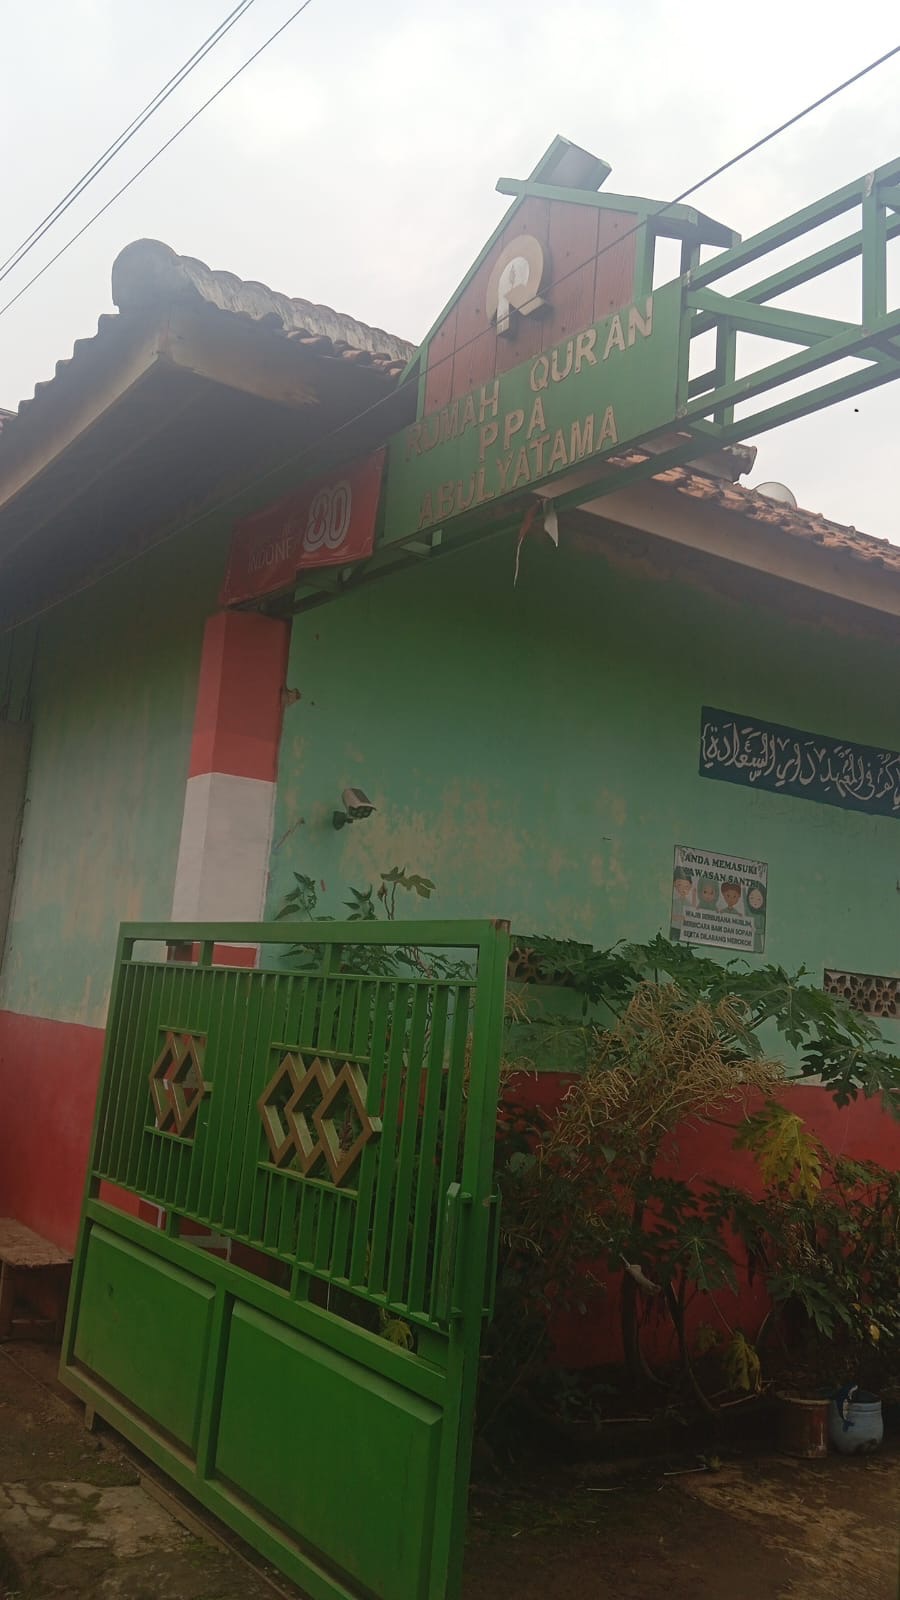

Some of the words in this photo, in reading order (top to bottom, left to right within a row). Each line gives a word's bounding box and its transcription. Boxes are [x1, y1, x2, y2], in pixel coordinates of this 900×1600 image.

[405, 380, 499, 462] RUMAH
[529, 296, 653, 393] QURAN
[479, 397, 546, 463] PPA
[302, 481, 352, 552] 80
[684, 852, 710, 866] ANDA
[711, 858, 758, 875] MEMASUKI
[702, 912, 731, 923] BERBUSANA
[683, 930, 699, 938] SERTA
[700, 932, 727, 943] DILARANG
[723, 926, 734, 934] DAN
[735, 928, 753, 937] SOPAN
